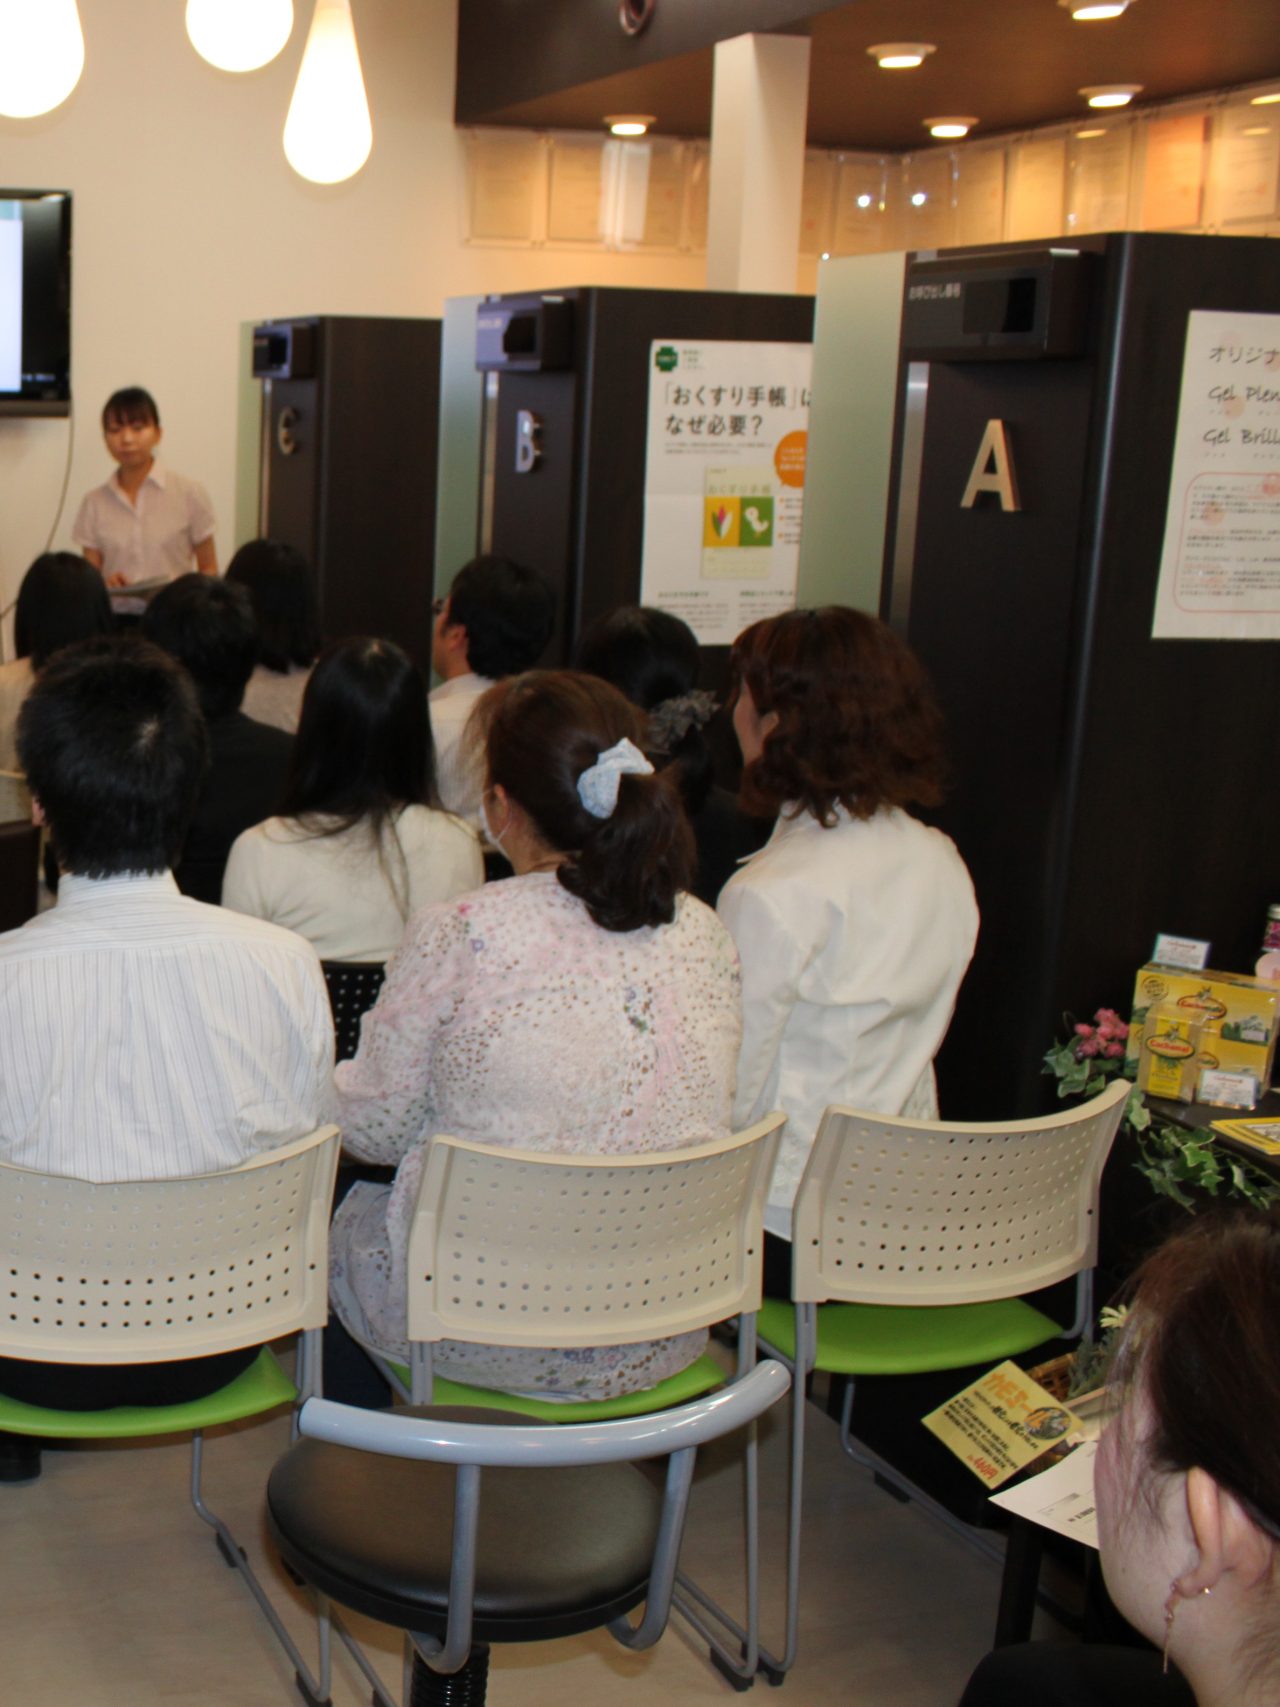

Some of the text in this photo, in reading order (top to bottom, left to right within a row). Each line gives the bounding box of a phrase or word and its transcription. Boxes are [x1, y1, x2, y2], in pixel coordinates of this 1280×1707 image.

[1208, 384, 1236, 404] Gel
[665, 415, 764, 435] なぜ必要？
[516, 409, 538, 473] B
[1203, 427, 1231, 447] Gel
[960, 418, 1020, 513] A
